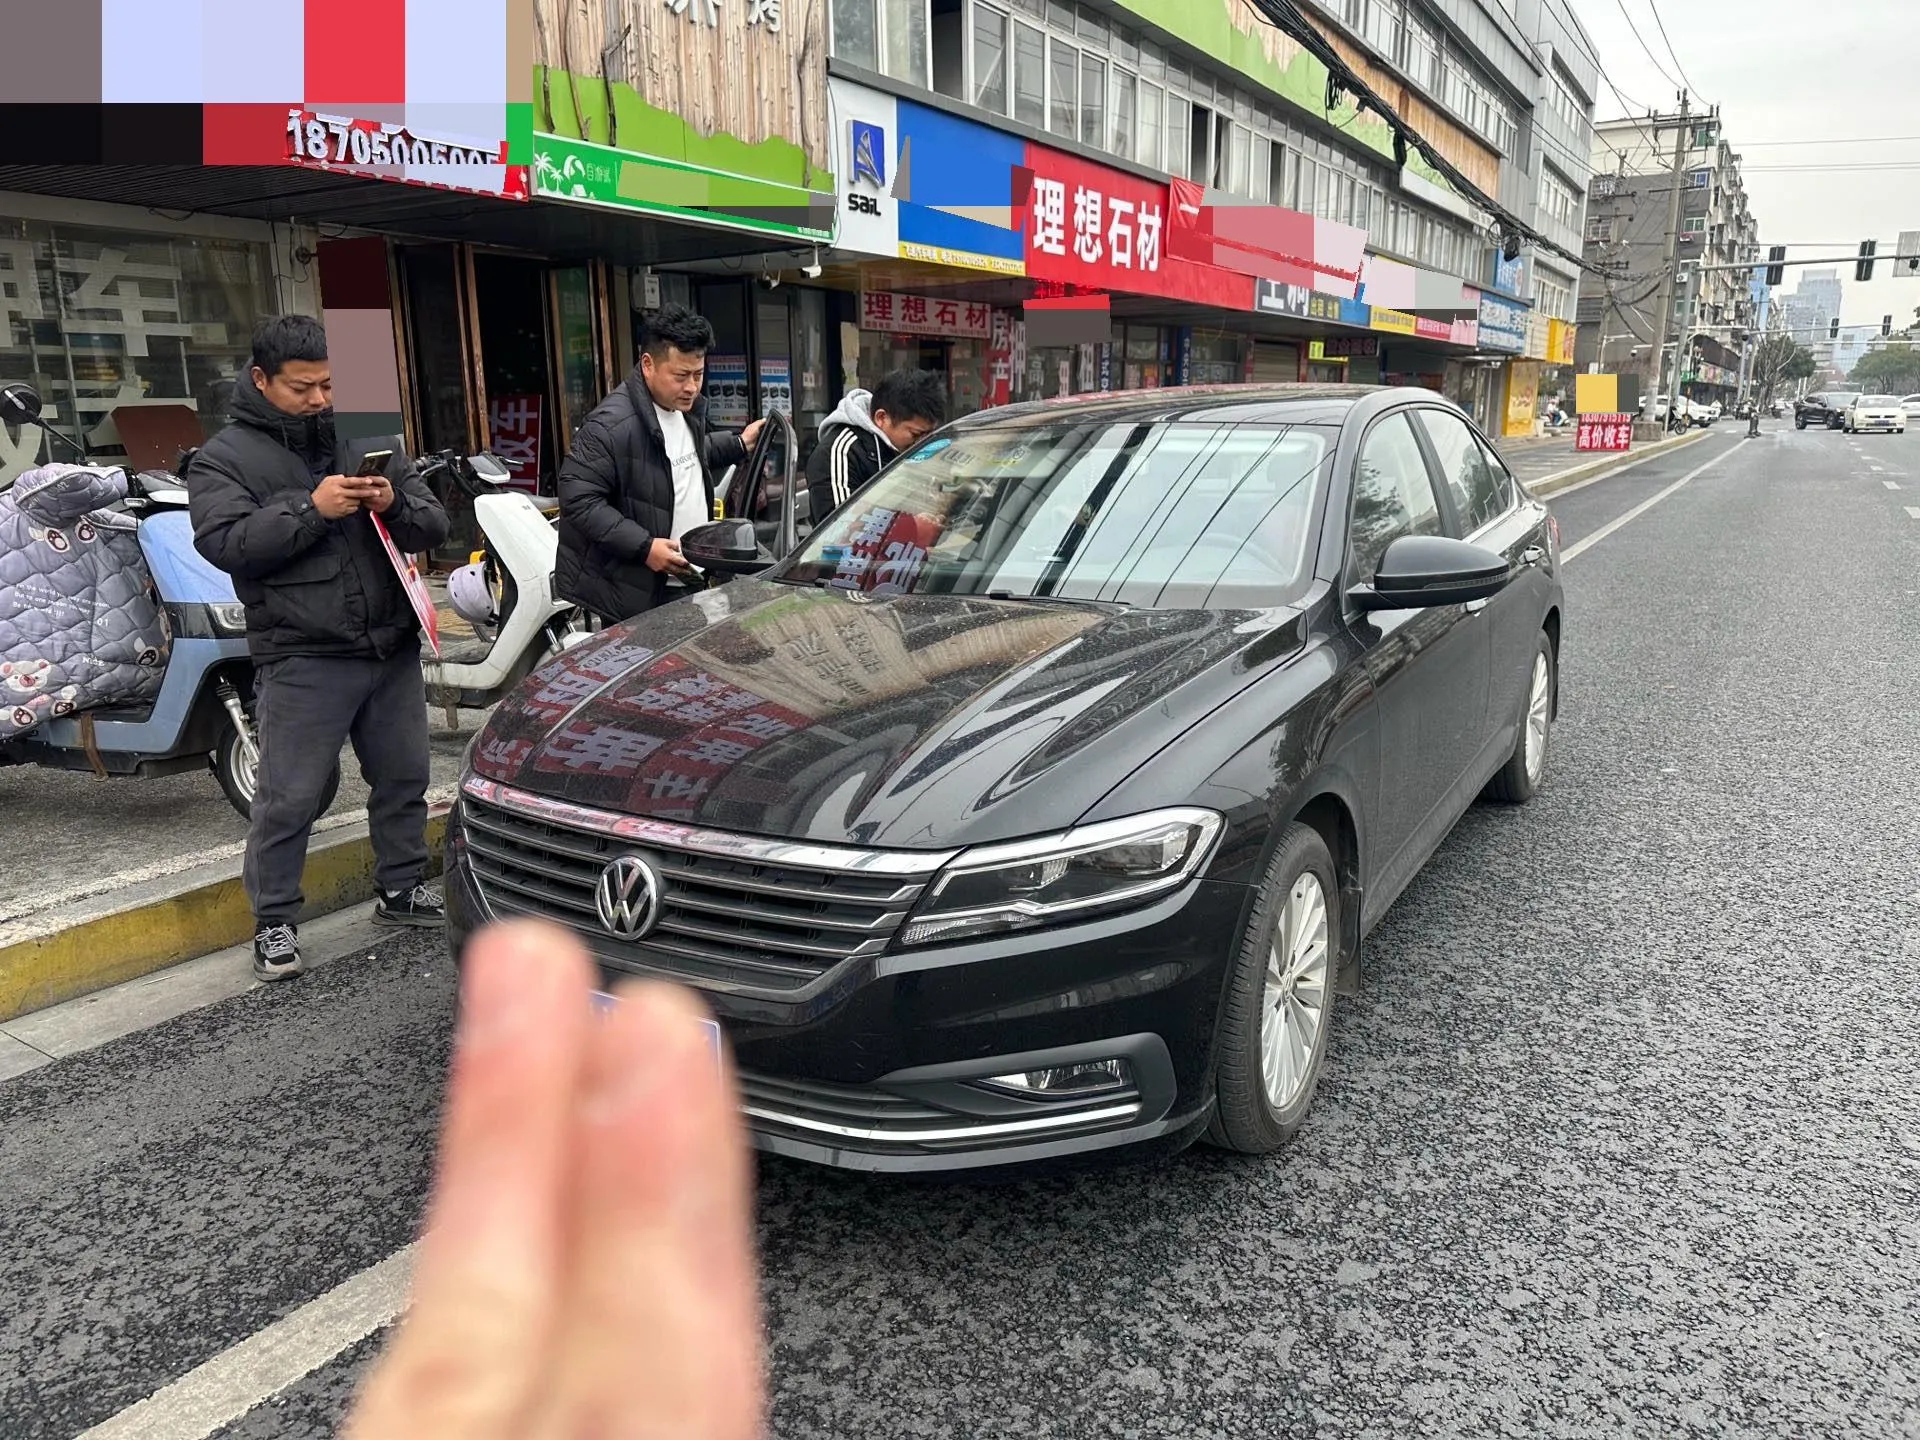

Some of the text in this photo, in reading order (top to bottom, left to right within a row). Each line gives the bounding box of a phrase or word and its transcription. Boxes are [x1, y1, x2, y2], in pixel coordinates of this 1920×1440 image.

[1033, 176, 1162, 272] 理想石材
[864, 291, 988, 329] 理想石材
[1578, 424, 1630, 449] 高价收车
